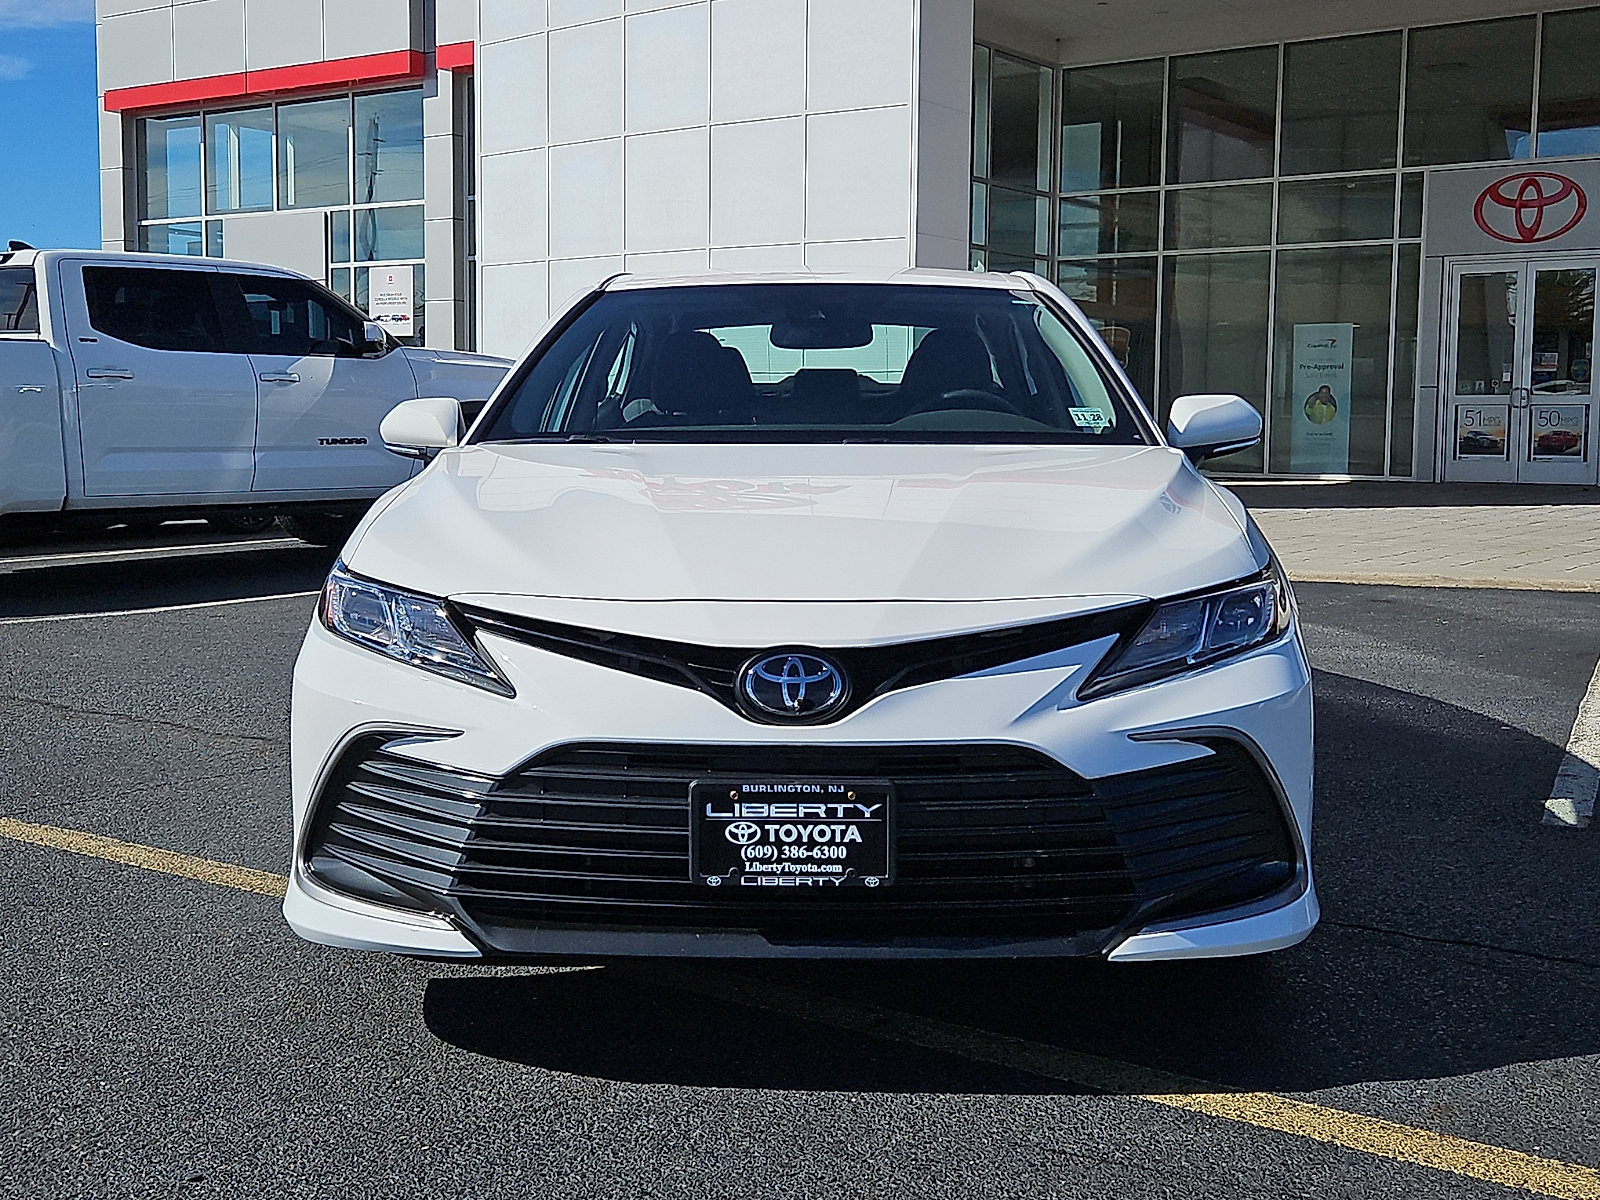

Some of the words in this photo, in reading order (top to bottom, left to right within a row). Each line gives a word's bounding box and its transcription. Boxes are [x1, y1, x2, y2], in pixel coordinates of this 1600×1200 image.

[1299, 362, 1344, 371] Pre-Approval
[1464, 409, 1483, 427] 51
[1538, 410, 1560, 427] 50
[317, 437, 368, 446] TUNDRA
[742, 784, 825, 793] BURLINGTON,
[828, 784, 845, 793] NJ
[705, 802, 883, 818] LIBERTY
[764, 824, 863, 843] TOYOTA
[740, 845, 778, 861] (609)
[781, 845, 847, 859] 386-6300
[744, 861, 843, 874] LibertyToyota.com
[740, 876, 848, 886] LIBERTY
